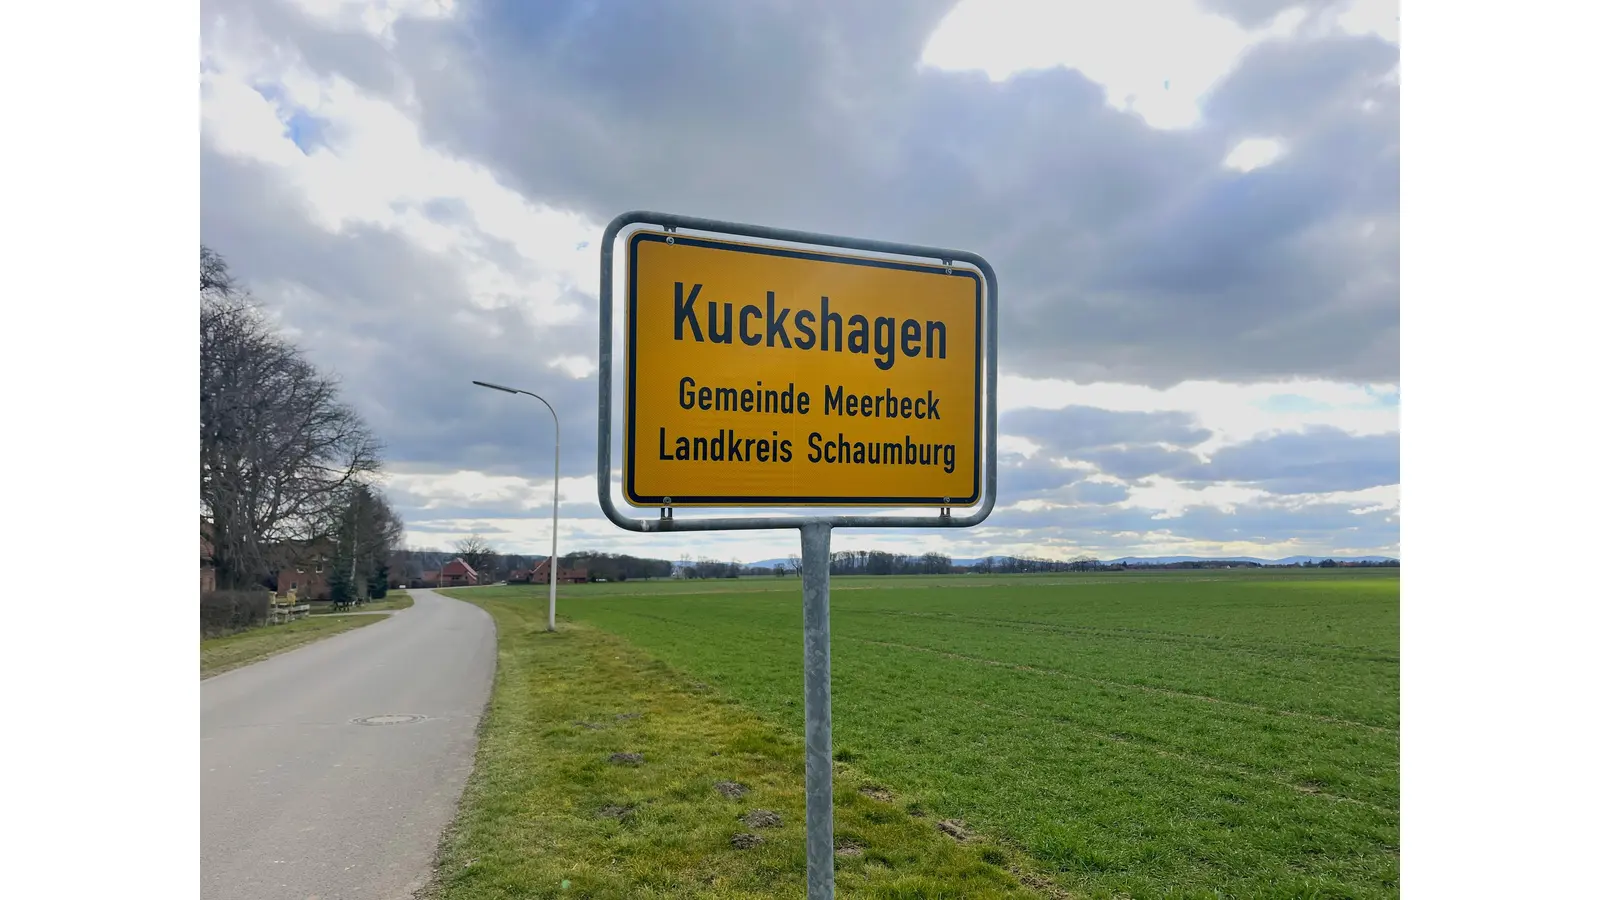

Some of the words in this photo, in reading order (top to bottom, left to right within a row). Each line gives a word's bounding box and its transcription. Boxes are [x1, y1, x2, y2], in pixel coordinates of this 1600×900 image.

[674, 282, 947, 371] Kuckshagen
[679, 377, 810, 415] Gemeinde
[824, 385, 941, 420] Meerbeck
[659, 427, 793, 463] Landkreis
[808, 432, 956, 474] Schaumburg
